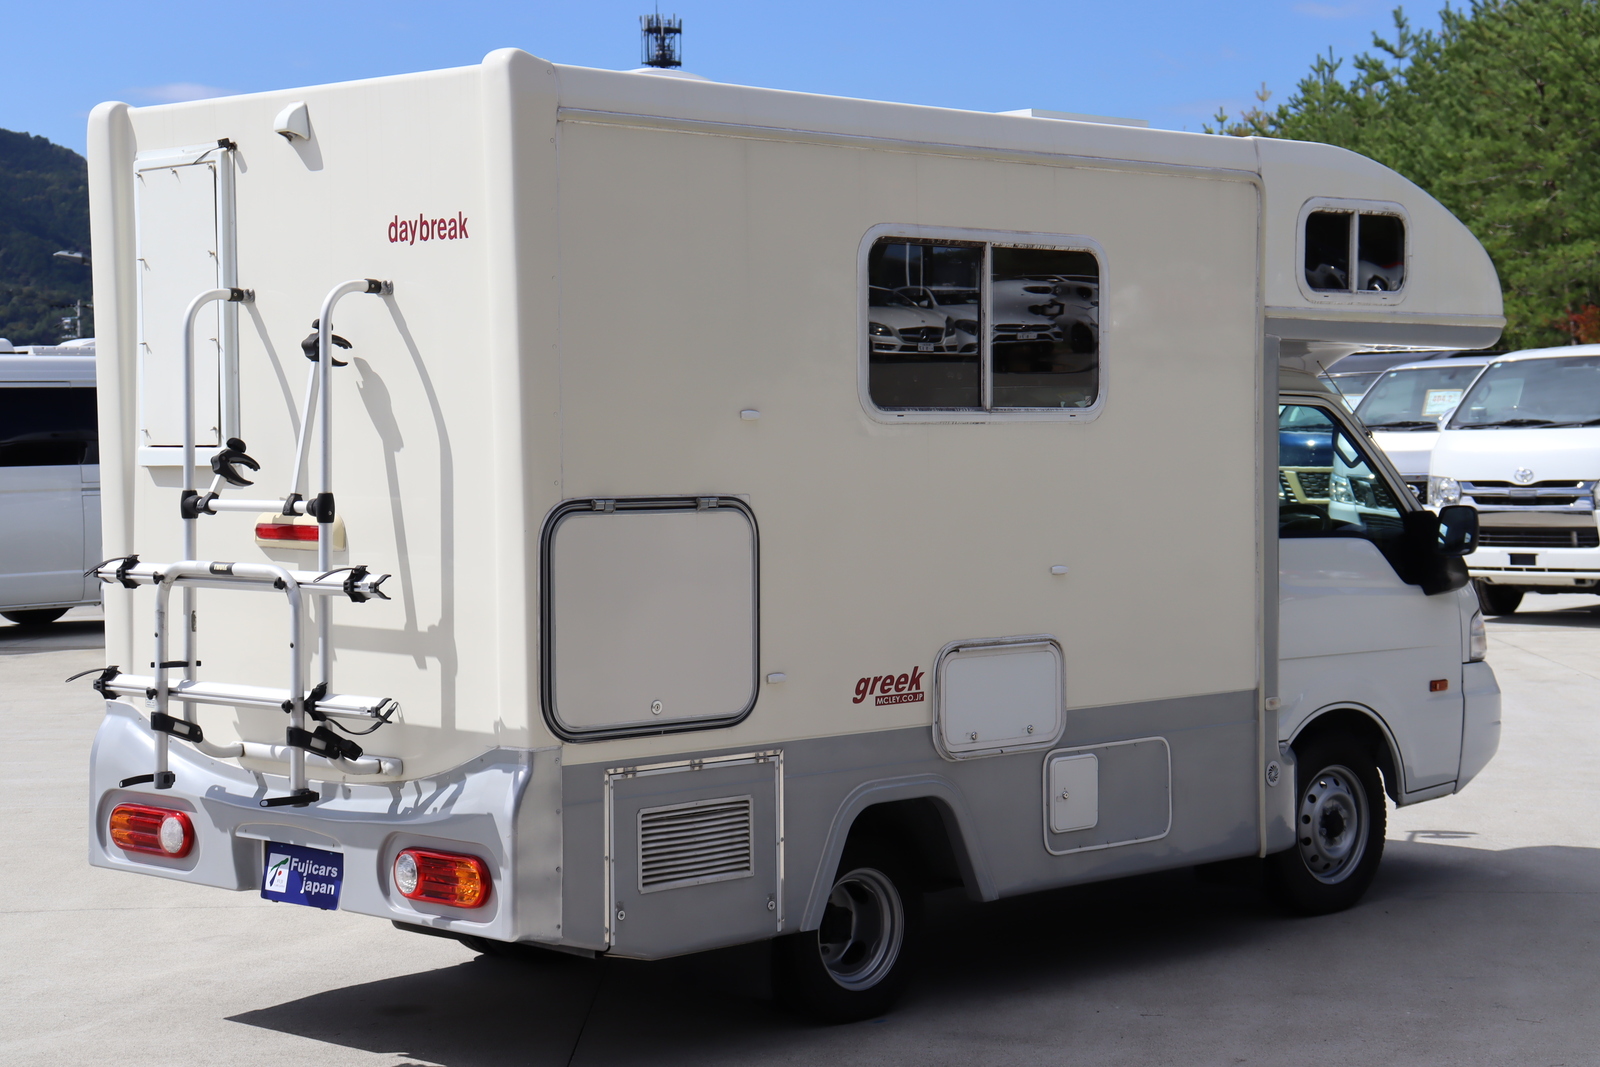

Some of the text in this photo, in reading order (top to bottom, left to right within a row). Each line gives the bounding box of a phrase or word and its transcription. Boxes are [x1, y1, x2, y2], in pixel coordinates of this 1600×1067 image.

[388, 211, 469, 246] daybreak
[852, 665, 925, 704] greek
[876, 693, 923, 705] MCLEY.CO.JP
[290, 857, 338, 878] Fujicars
[300, 877, 335, 896] japan
